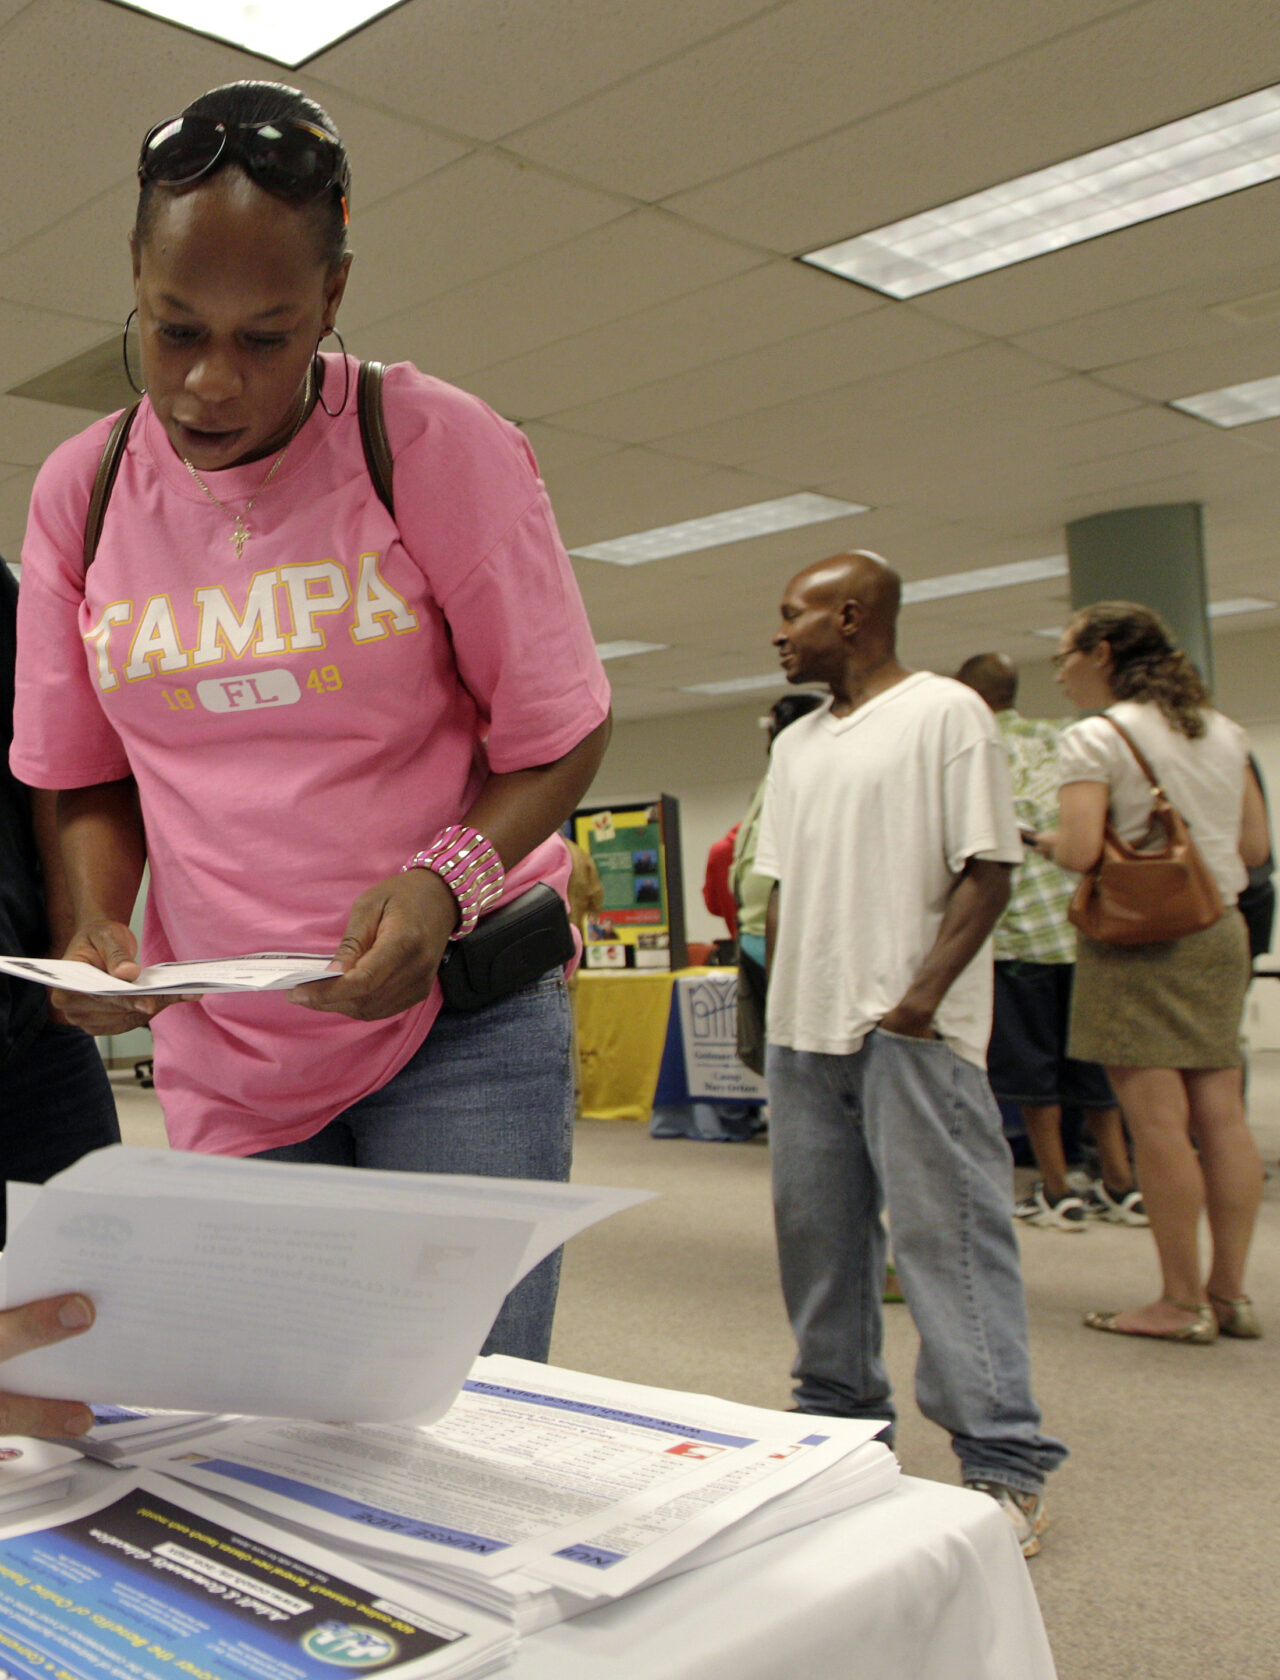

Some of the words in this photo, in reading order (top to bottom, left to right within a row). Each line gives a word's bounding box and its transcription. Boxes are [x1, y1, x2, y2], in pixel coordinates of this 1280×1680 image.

[83, 552, 419, 692] TAMPA
[160, 689, 196, 711] 18
[220, 677, 279, 708] FL
[306, 665, 343, 694] 49
[165, 1521, 192, 1533] each
[351, 1511, 405, 1533] AIDE
[90, 1530, 160, 1559] Education
[188, 1530, 220, 1546] launch
[414, 1528, 488, 1553] NURSE
[213, 1543, 253, 1560] classes
[248, 1558, 276, 1570] new
[150, 1557, 236, 1593] Community
[270, 1567, 309, 1586] Several
[30, 1584, 73, 1608] Online
[222, 1590, 240, 1599] &
[68, 1606, 91, 1616] of
[236, 1597, 288, 1620] Adult
[355, 1604, 394, 1623] online
[91, 1614, 148, 1647] Benefits
[390, 1620, 415, 1634] 400
[147, 1645, 174, 1661] the
